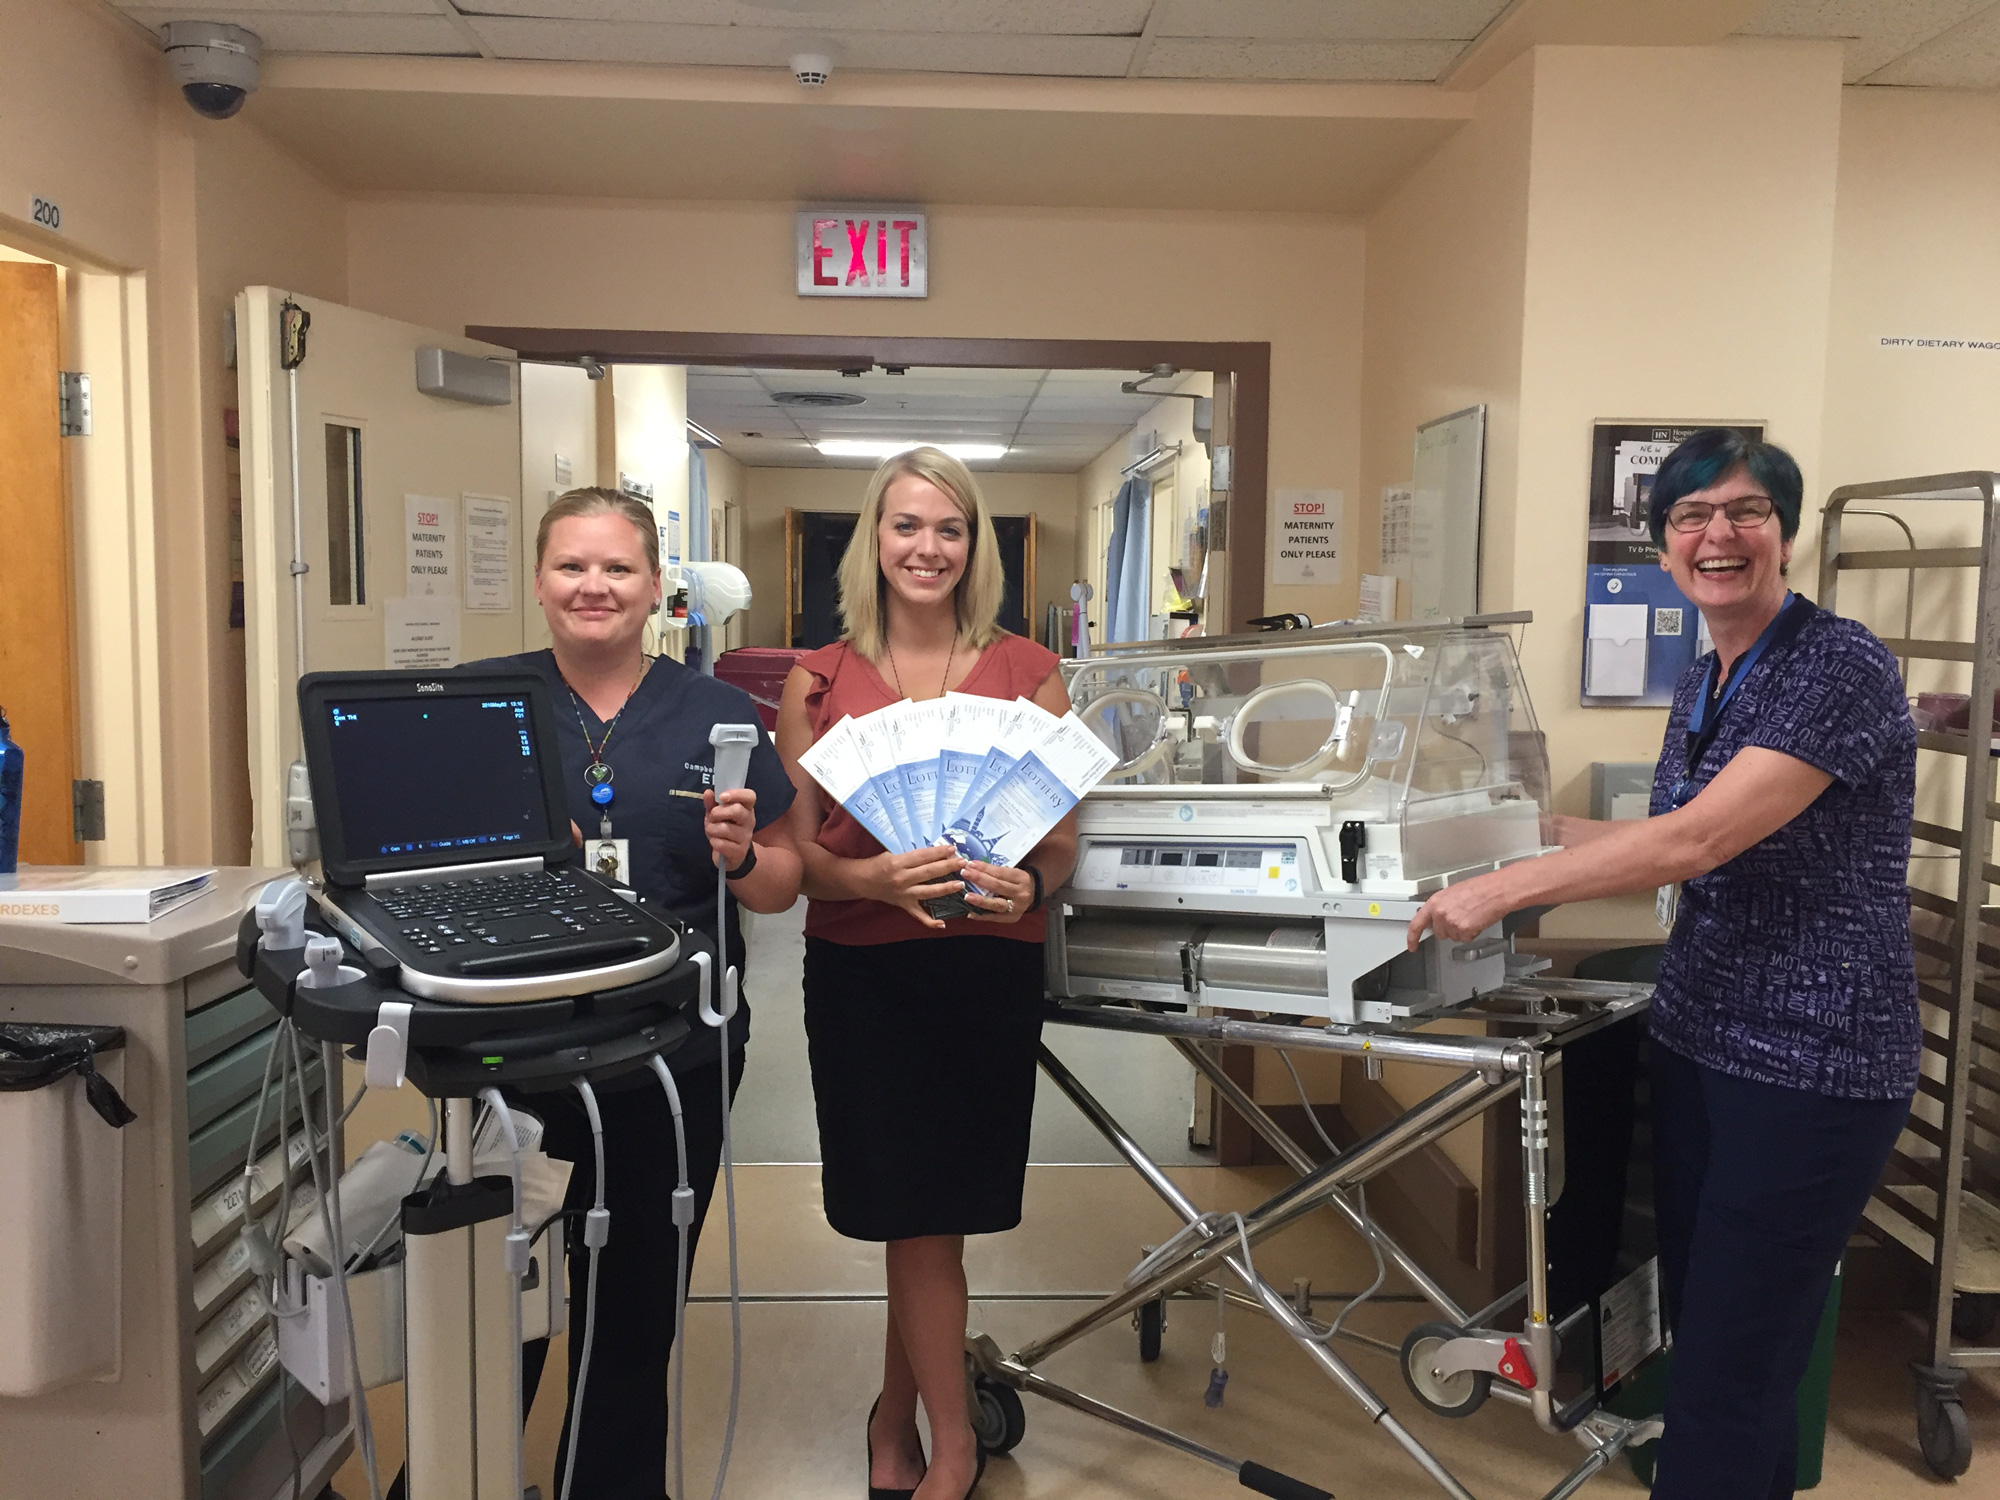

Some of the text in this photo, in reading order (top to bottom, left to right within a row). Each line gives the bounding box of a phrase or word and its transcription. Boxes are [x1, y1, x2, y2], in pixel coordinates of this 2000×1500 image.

[34, 198, 60, 229] 200
[812, 219, 918, 288] EXIT
[1881, 337, 1914, 346] DIRTY
[1917, 339, 1965, 348] DIETARY
[1654, 430, 1668, 439] HN
[1640, 445, 1662, 453] NEW
[1293, 503, 1325, 514] STOP!
[417, 512, 439, 525] STOP!
[1284, 521, 1334, 530] MATERNITY
[412, 533, 446, 543] MATERNITY
[1288, 536, 1329, 544] PATIENTS
[415, 549, 443, 559] PATIENTS
[1280, 550, 1336, 559] ONLY PLEASE
[410, 565, 448, 575] ONLY PLEASE
[416, 683, 444, 693] SonoSite
[1020, 761, 1066, 809] LOTTERY
[1824, 939, 1857, 961] LOVE
[1816, 1008, 1853, 1034] LOVE
